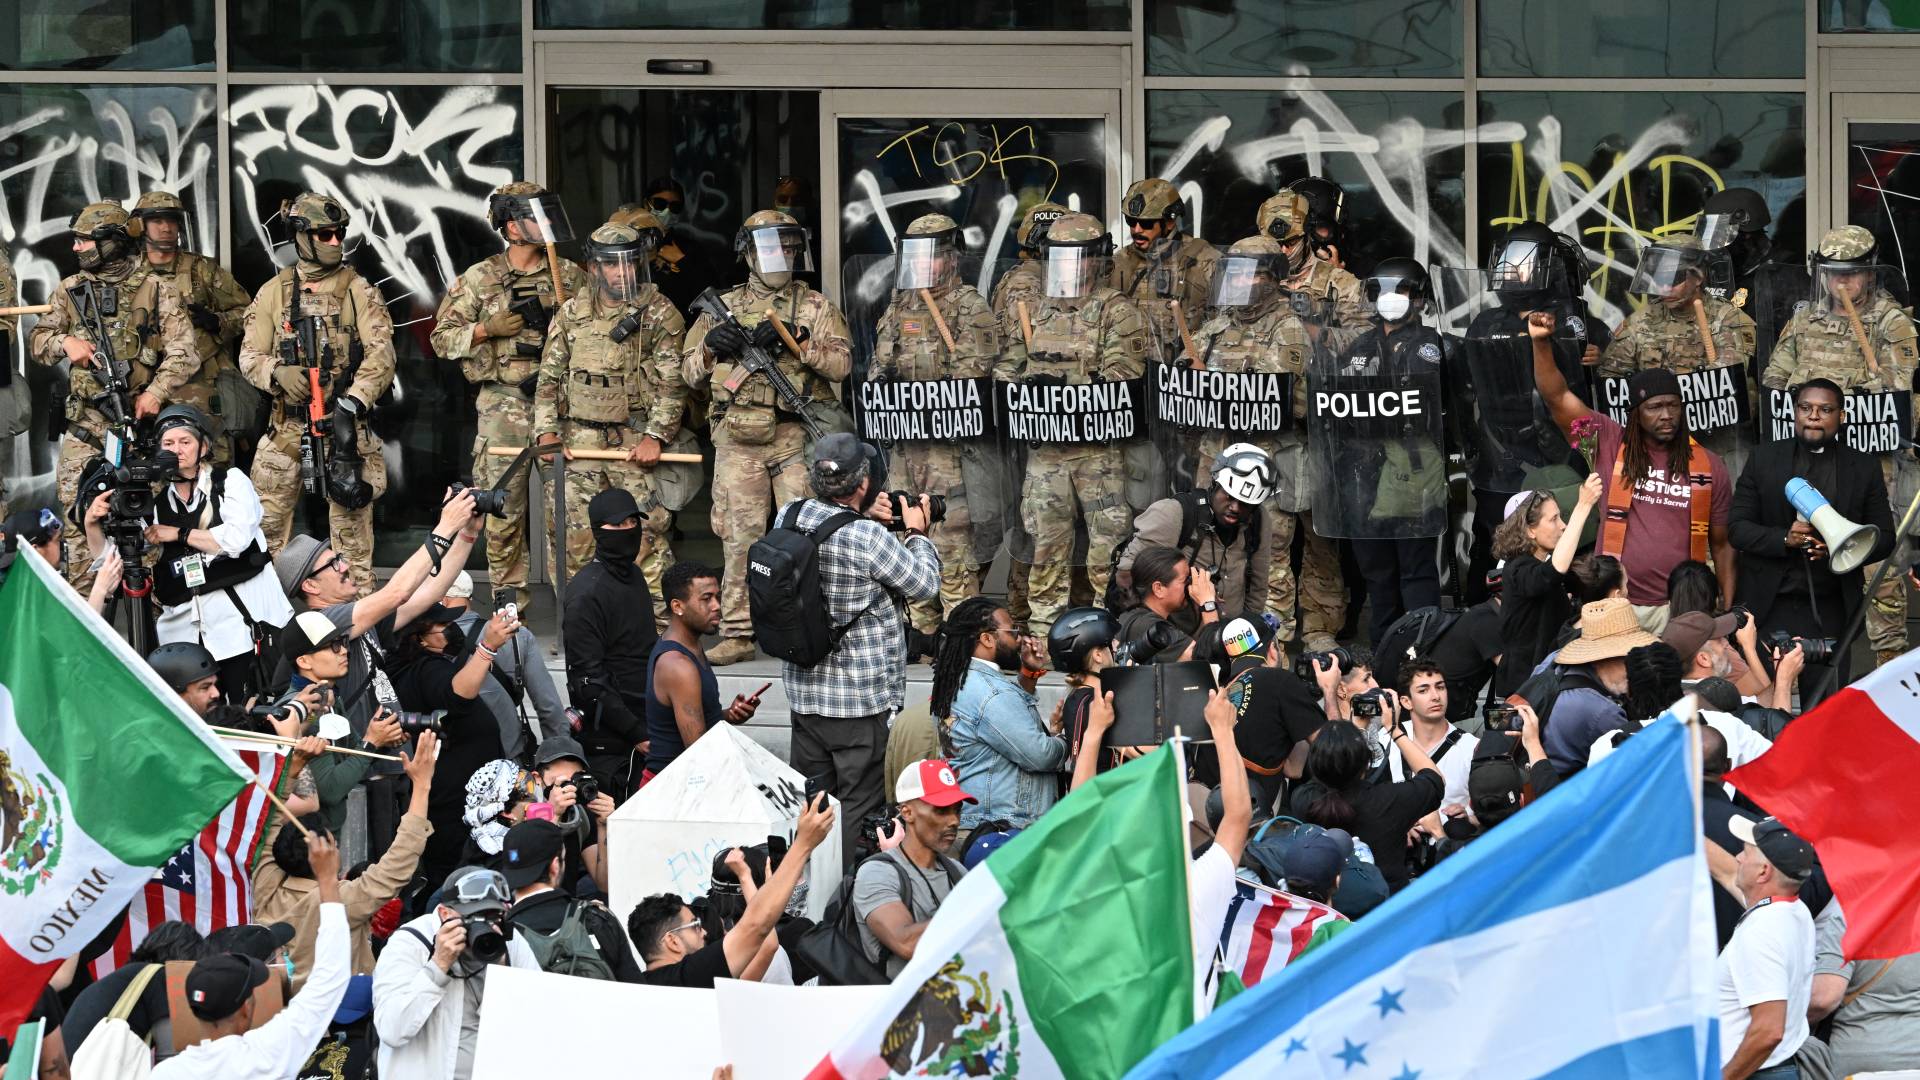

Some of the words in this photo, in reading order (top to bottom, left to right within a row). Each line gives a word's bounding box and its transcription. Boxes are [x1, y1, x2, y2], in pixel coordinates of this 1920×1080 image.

[862, 378, 981, 411] CALIFORNIA
[1006, 381, 1133, 413] CALIFORNIA
[1158, 363, 1281, 402] CALIFORNIA
[1605, 367, 1736, 406] CARNIA
[1159, 393, 1225, 429] NATIONAL
[1229, 402, 1281, 431] GUARD
[1316, 389, 1422, 418] POLICE
[1686, 396, 1739, 432] GUARD
[1770, 389, 1898, 425] CARNIA
[864, 408, 929, 440] NATIONAL
[932, 407, 983, 438] GUARD
[1008, 411, 1080, 442] NATIONAL
[1083, 410, 1134, 442] GUARD
[1846, 422, 1899, 453] GUARD
[751, 561, 771, 577] PRESS
